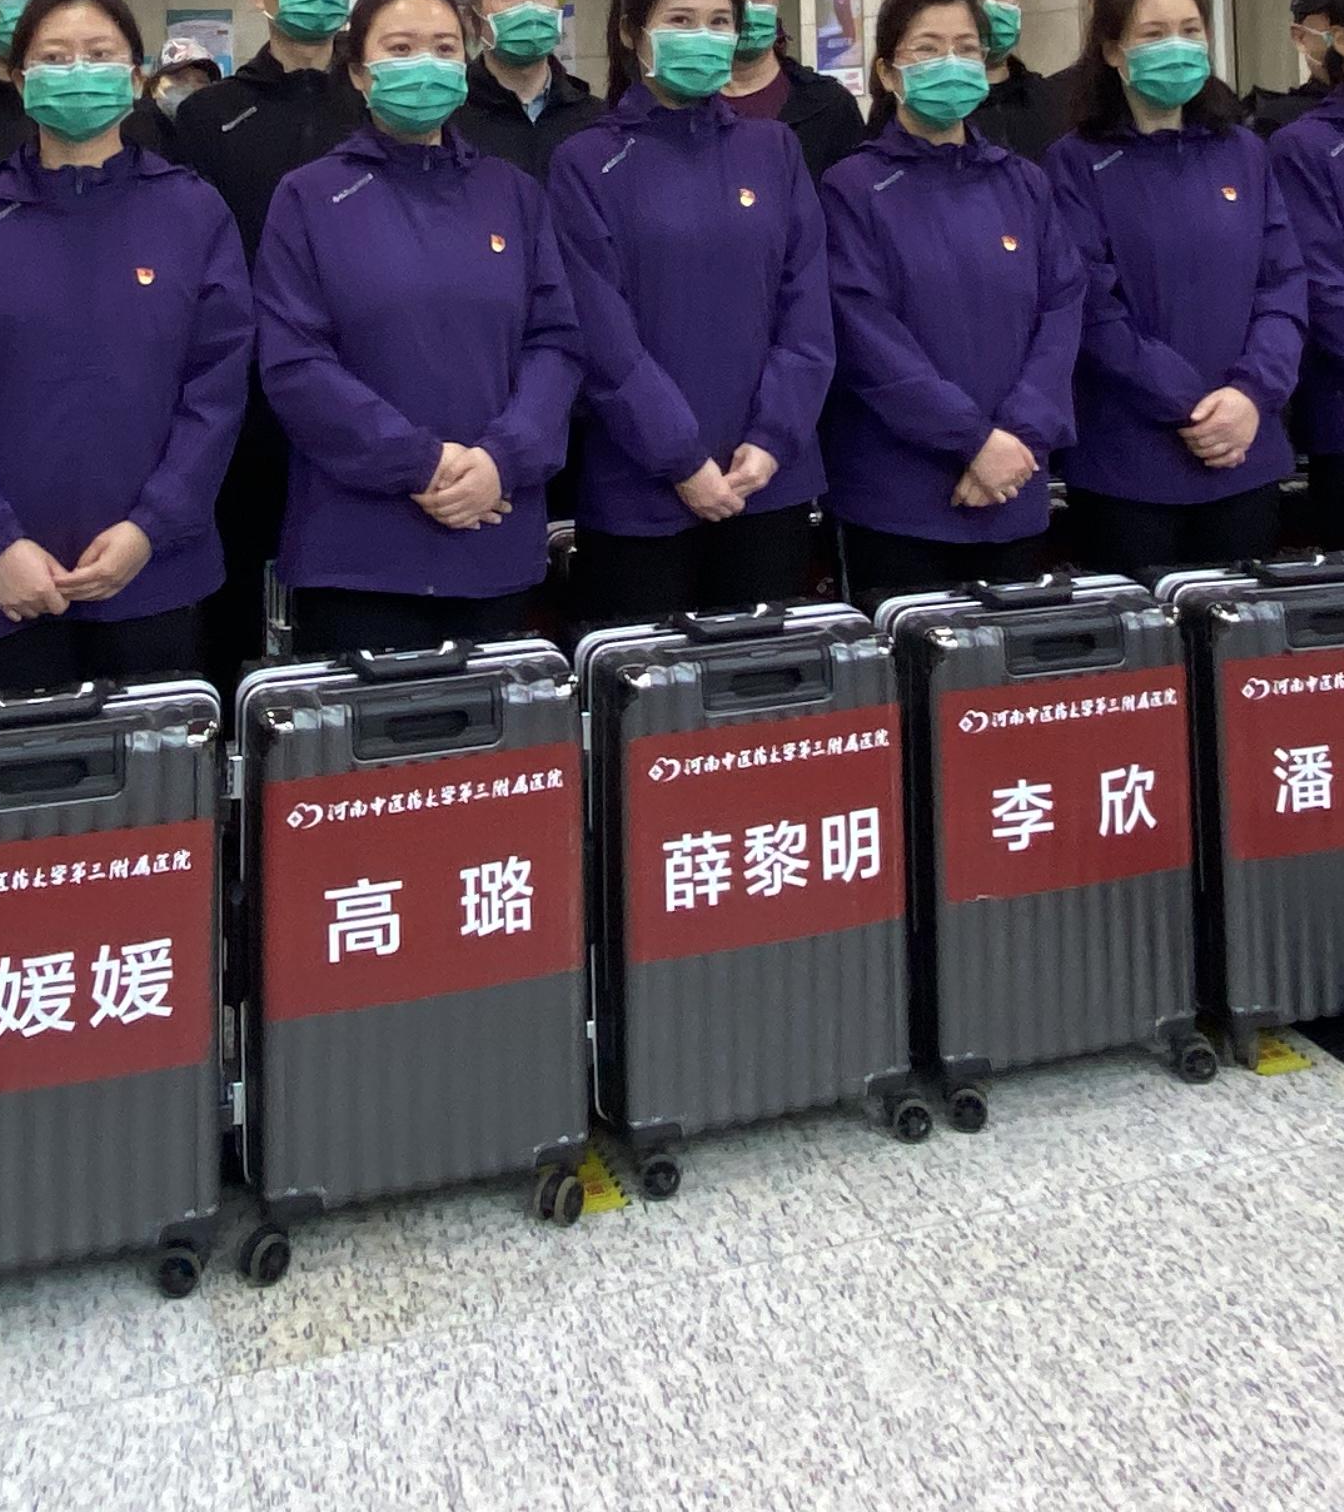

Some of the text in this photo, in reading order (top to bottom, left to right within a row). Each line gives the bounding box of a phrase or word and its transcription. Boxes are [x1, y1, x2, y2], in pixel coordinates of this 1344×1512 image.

[662, 806, 881, 913] 薛黎明
[991, 763, 1158, 853] 李欣
[323, 855, 535, 964] 高璐
